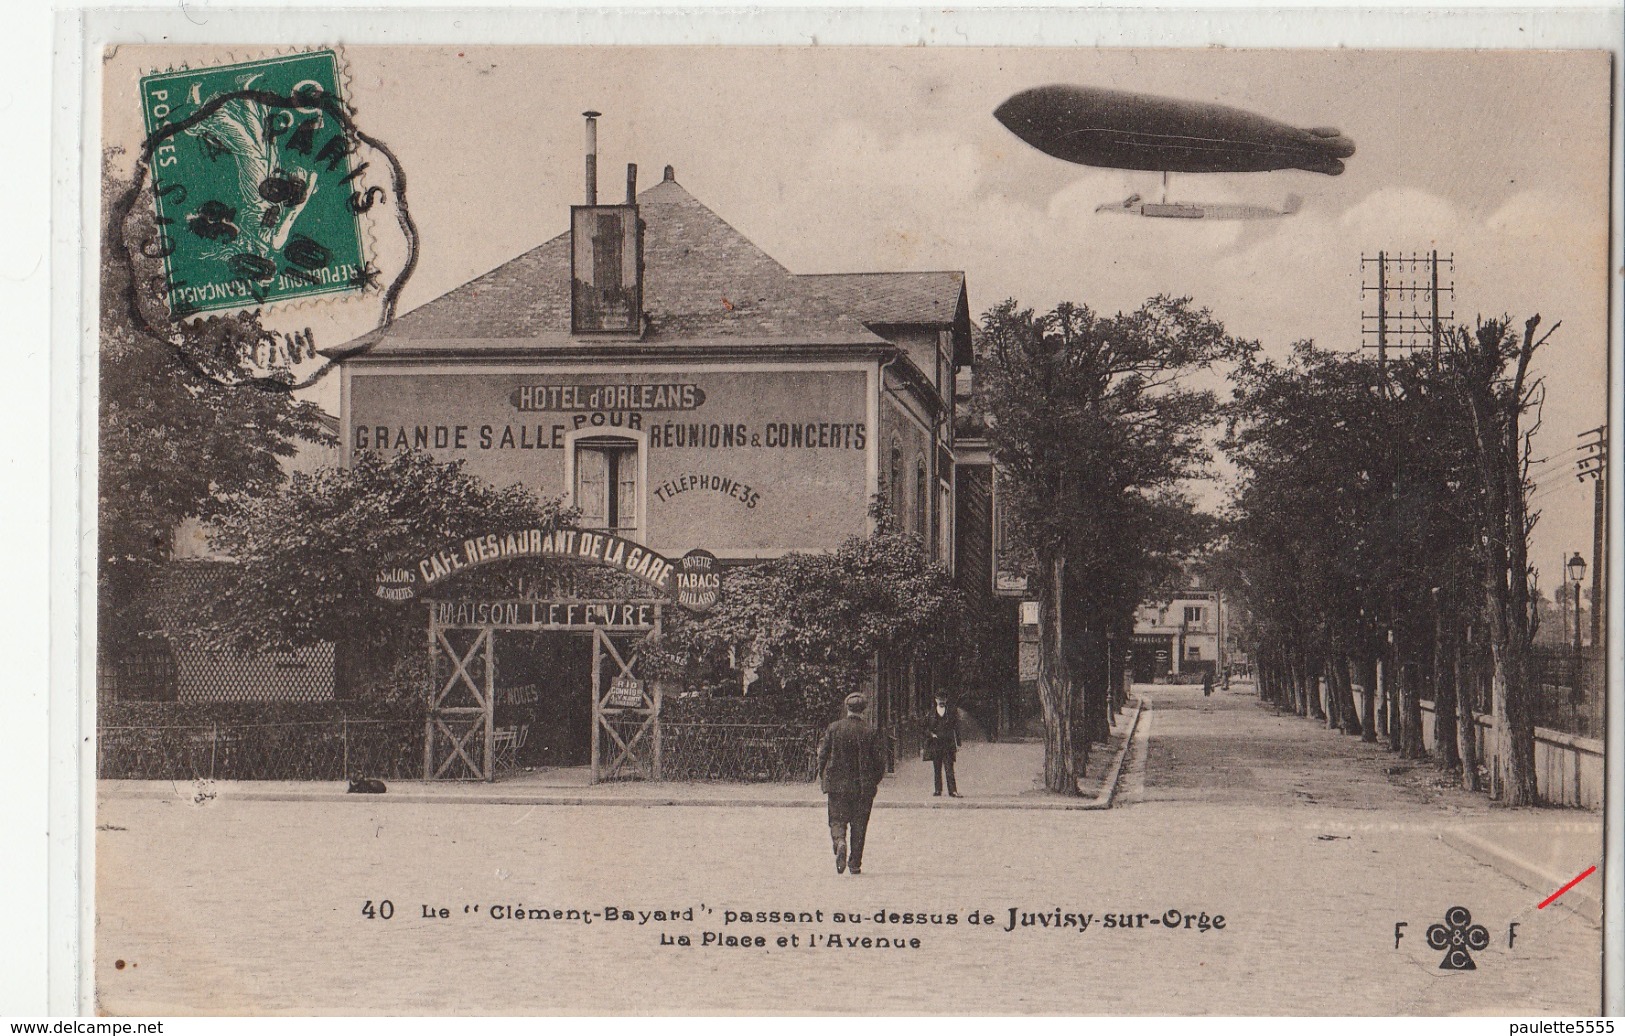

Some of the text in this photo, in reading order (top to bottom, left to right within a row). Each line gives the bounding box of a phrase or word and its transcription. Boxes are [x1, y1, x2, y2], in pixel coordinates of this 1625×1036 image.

[520, 385, 696, 409] HOTEL d'ORLEANS
[573, 412, 642, 430] POUR
[355, 420, 866, 450] GRANDE SALLE RÉUNIONS & CONCERTS
[653, 473, 741, 503] TÉLÉPHONE
[464, 529, 576, 563] RESTAURANT
[579, 532, 603, 558] DE
[604, 538, 625, 565] LA
[626, 547, 674, 586] GARE
[380, 568, 415, 583] SALONS
[677, 573, 720, 588] TABACS
[679, 590, 716, 604] BILLARD
[439, 603, 518, 624] MAISON
